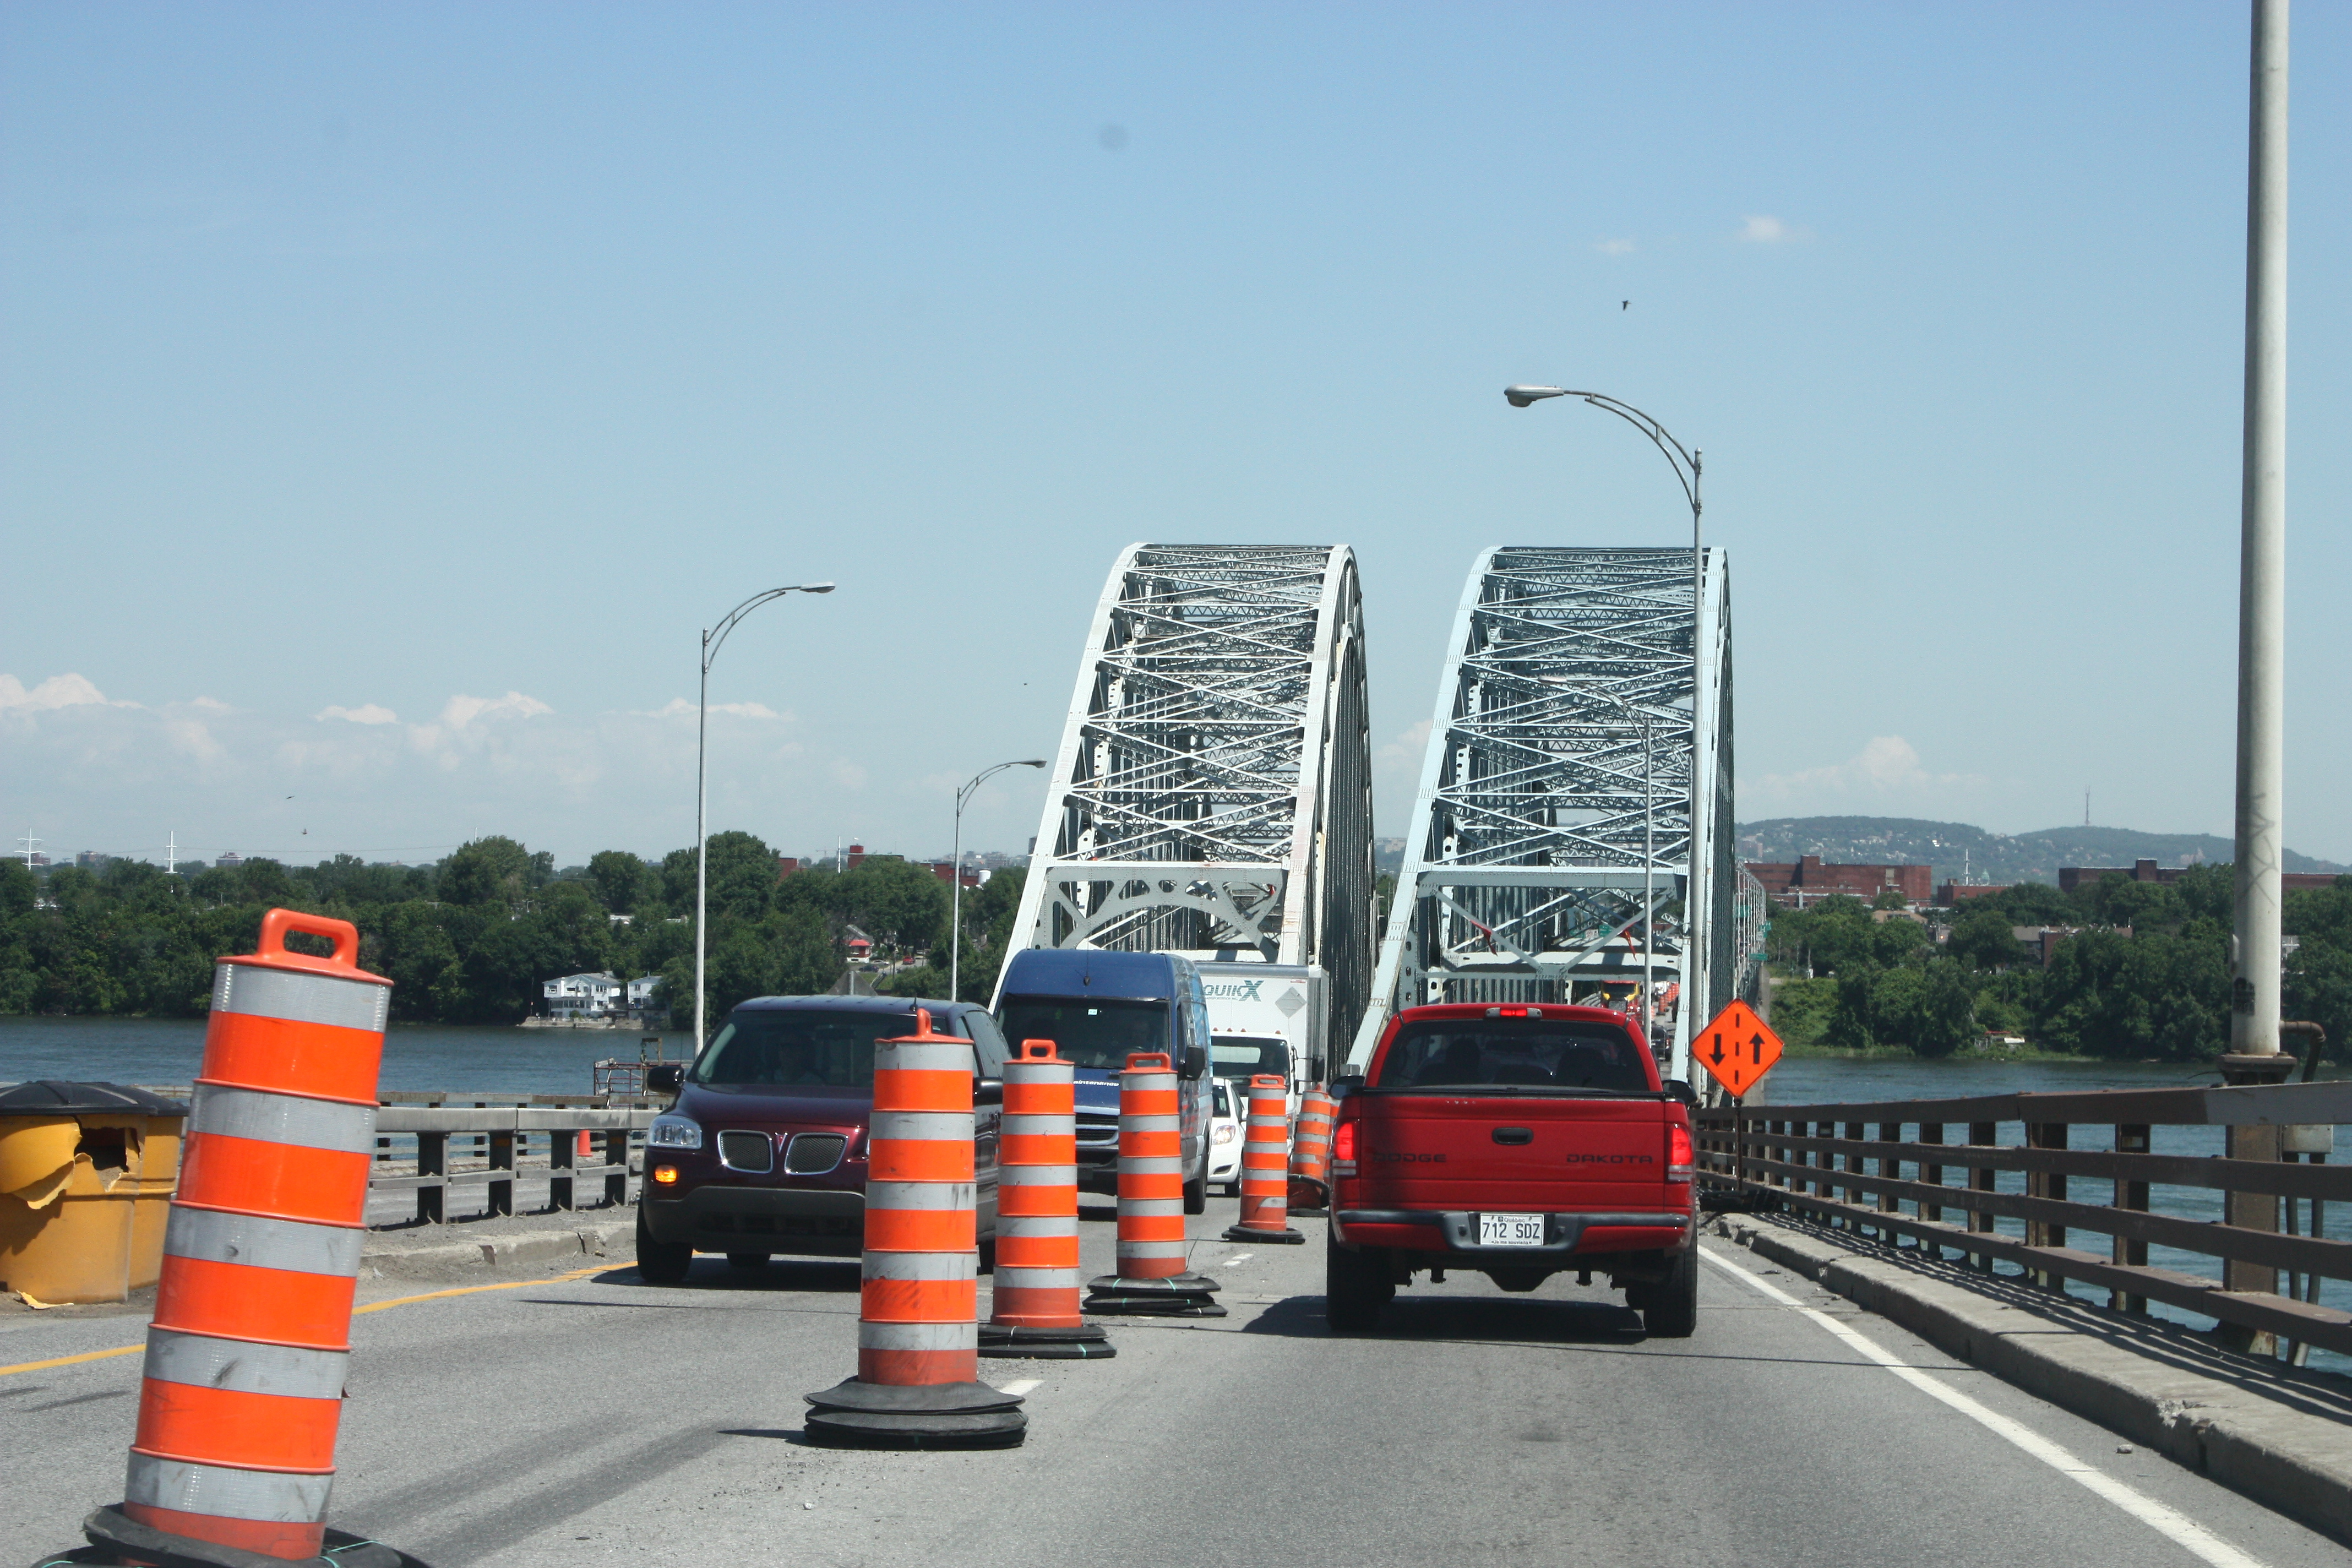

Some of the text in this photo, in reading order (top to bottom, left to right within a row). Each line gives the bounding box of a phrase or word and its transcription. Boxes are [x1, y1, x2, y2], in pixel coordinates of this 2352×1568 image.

[1373, 1152, 1447, 1163] DODGE
[1566, 1153, 1653, 1164] DAKOTA
[1482, 1222, 1540, 1239] 712 SDZ
